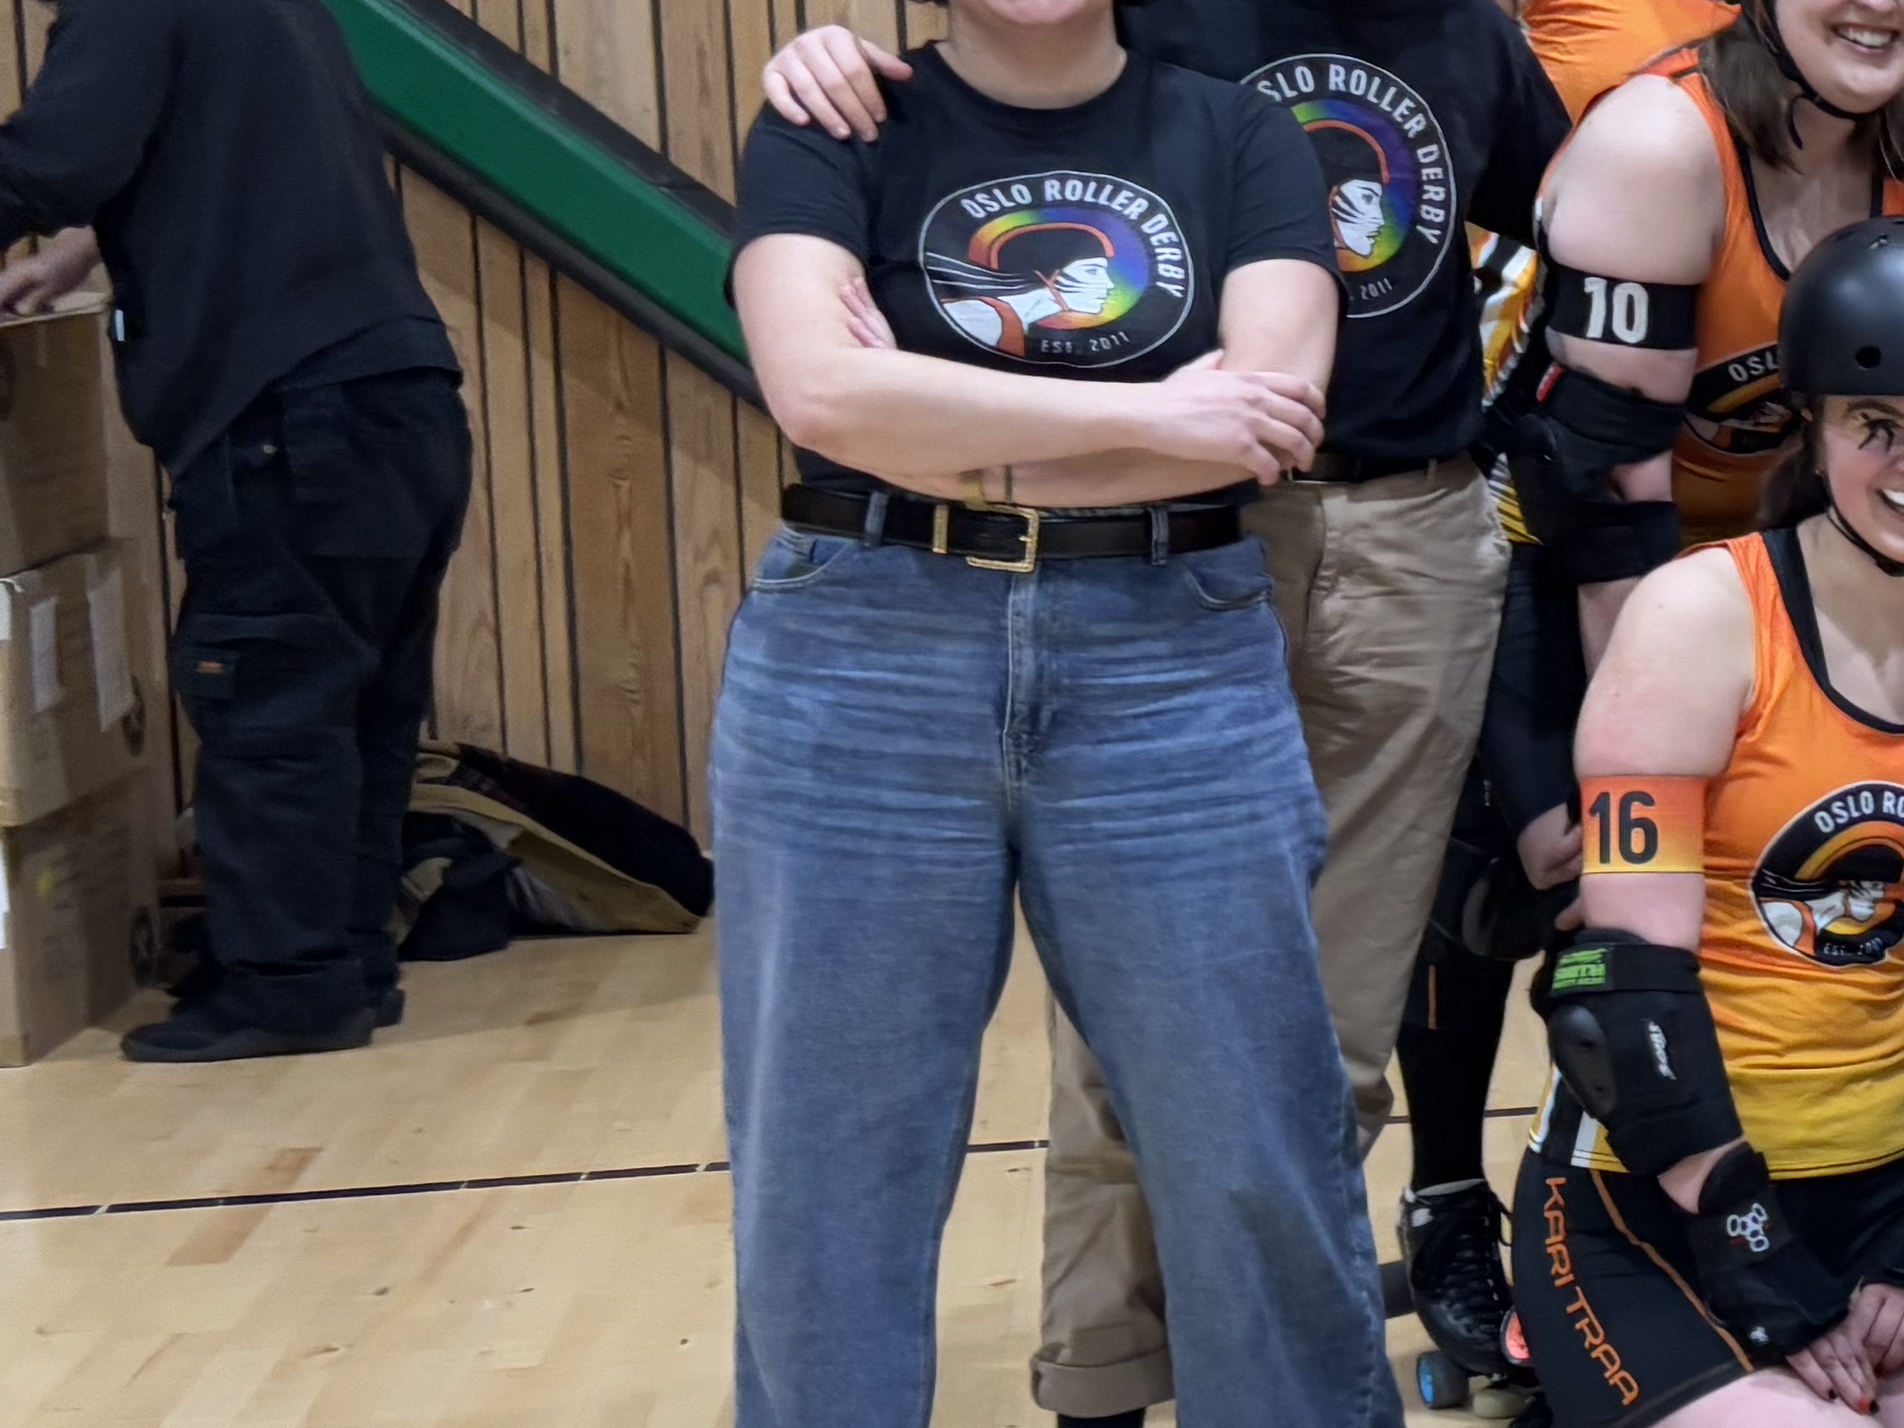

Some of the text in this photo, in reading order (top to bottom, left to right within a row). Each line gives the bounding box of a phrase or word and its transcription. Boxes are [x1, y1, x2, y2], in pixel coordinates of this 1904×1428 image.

[1257, 64, 1446, 244] SLO ROLLER DERBY
[961, 179, 1186, 299] OSLO ROLLER DERBY
[1584, 277, 1649, 344] 10
[1728, 351, 1779, 382] OSL
[1588, 789, 1659, 866] 16
[1814, 791, 1874, 834] OSLO
[1543, 1175, 1641, 1408] KARI TRAA
